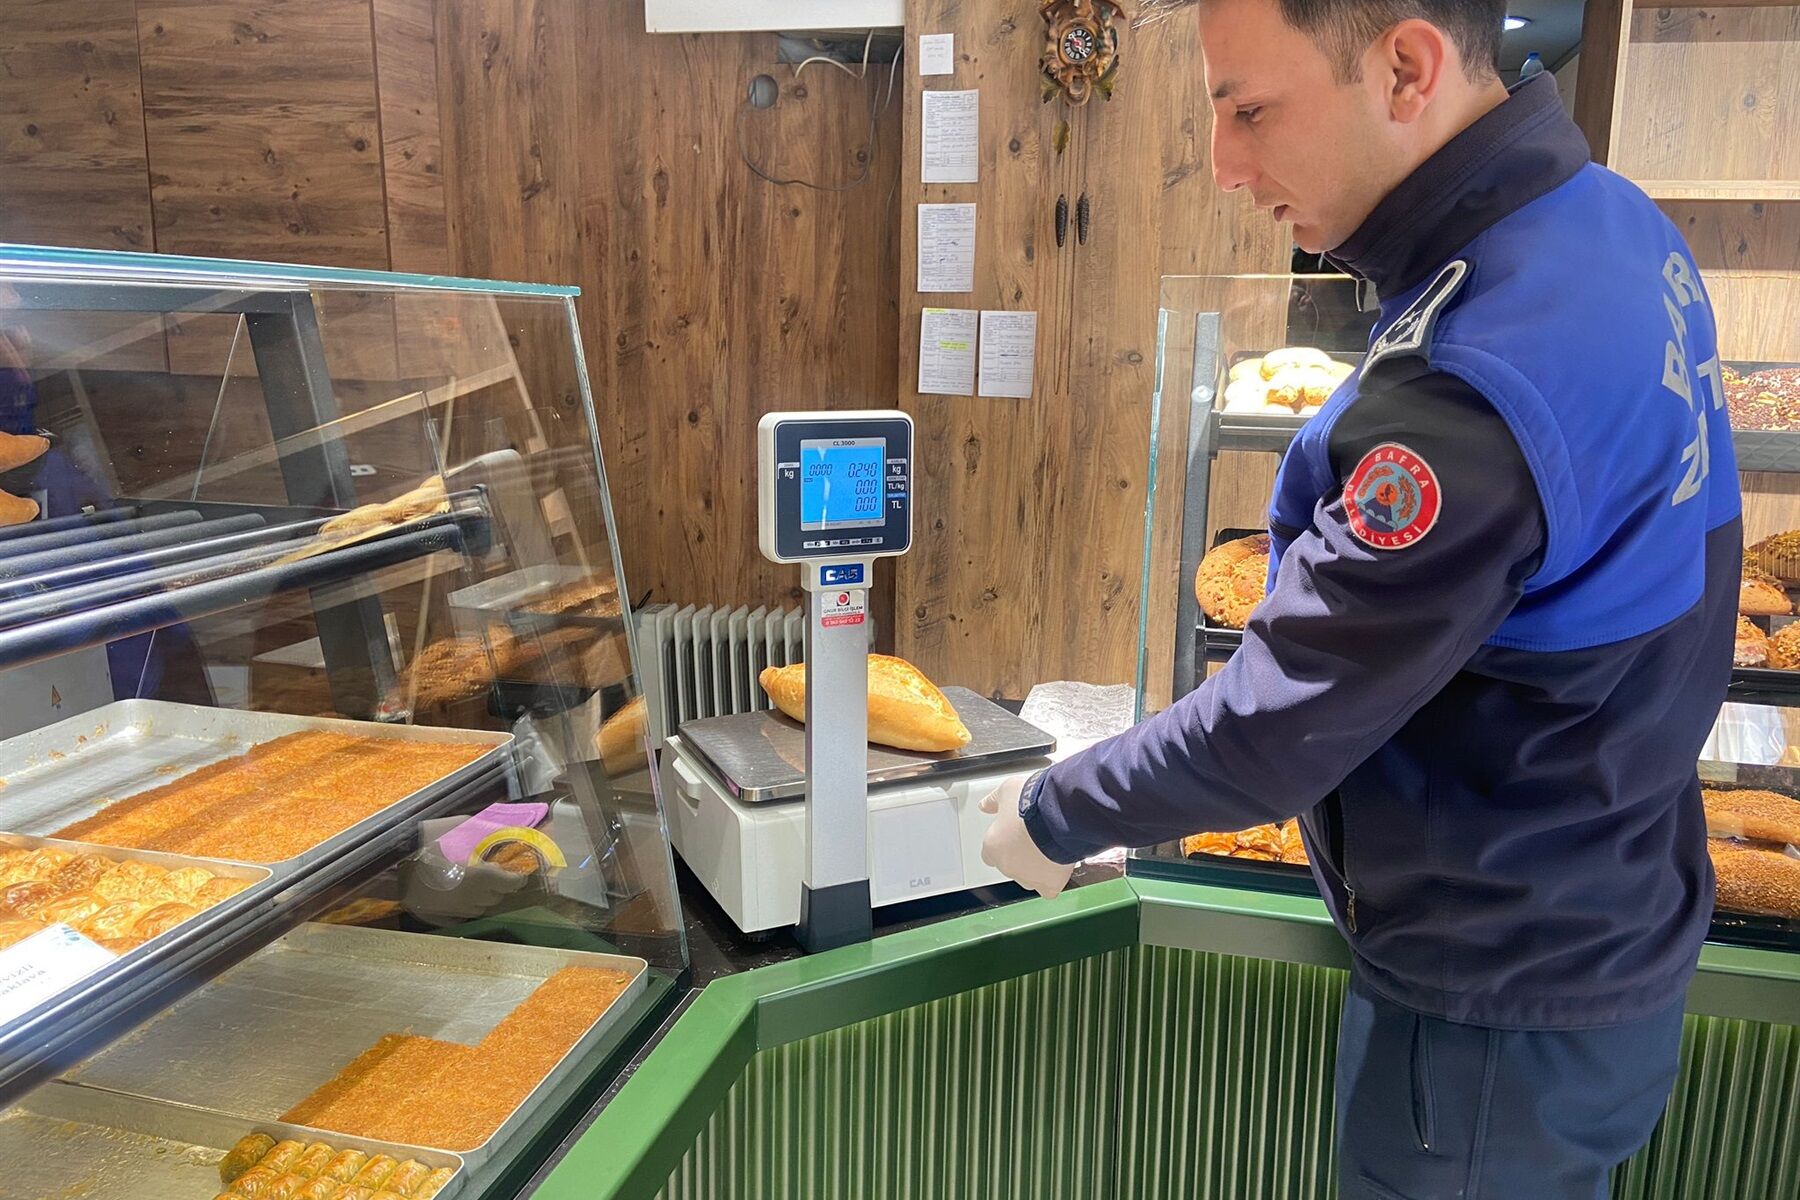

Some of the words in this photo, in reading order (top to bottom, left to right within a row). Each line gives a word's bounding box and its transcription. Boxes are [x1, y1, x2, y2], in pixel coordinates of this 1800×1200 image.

[784, 469, 794, 480] kg
[892, 465, 902, 475] kg
[1375, 451, 1430, 489] BAFRA
[888, 482, 905, 491] TL/kg
[891, 500, 902, 509] TL
[1345, 483, 1423, 546] BELEDİYESİ
